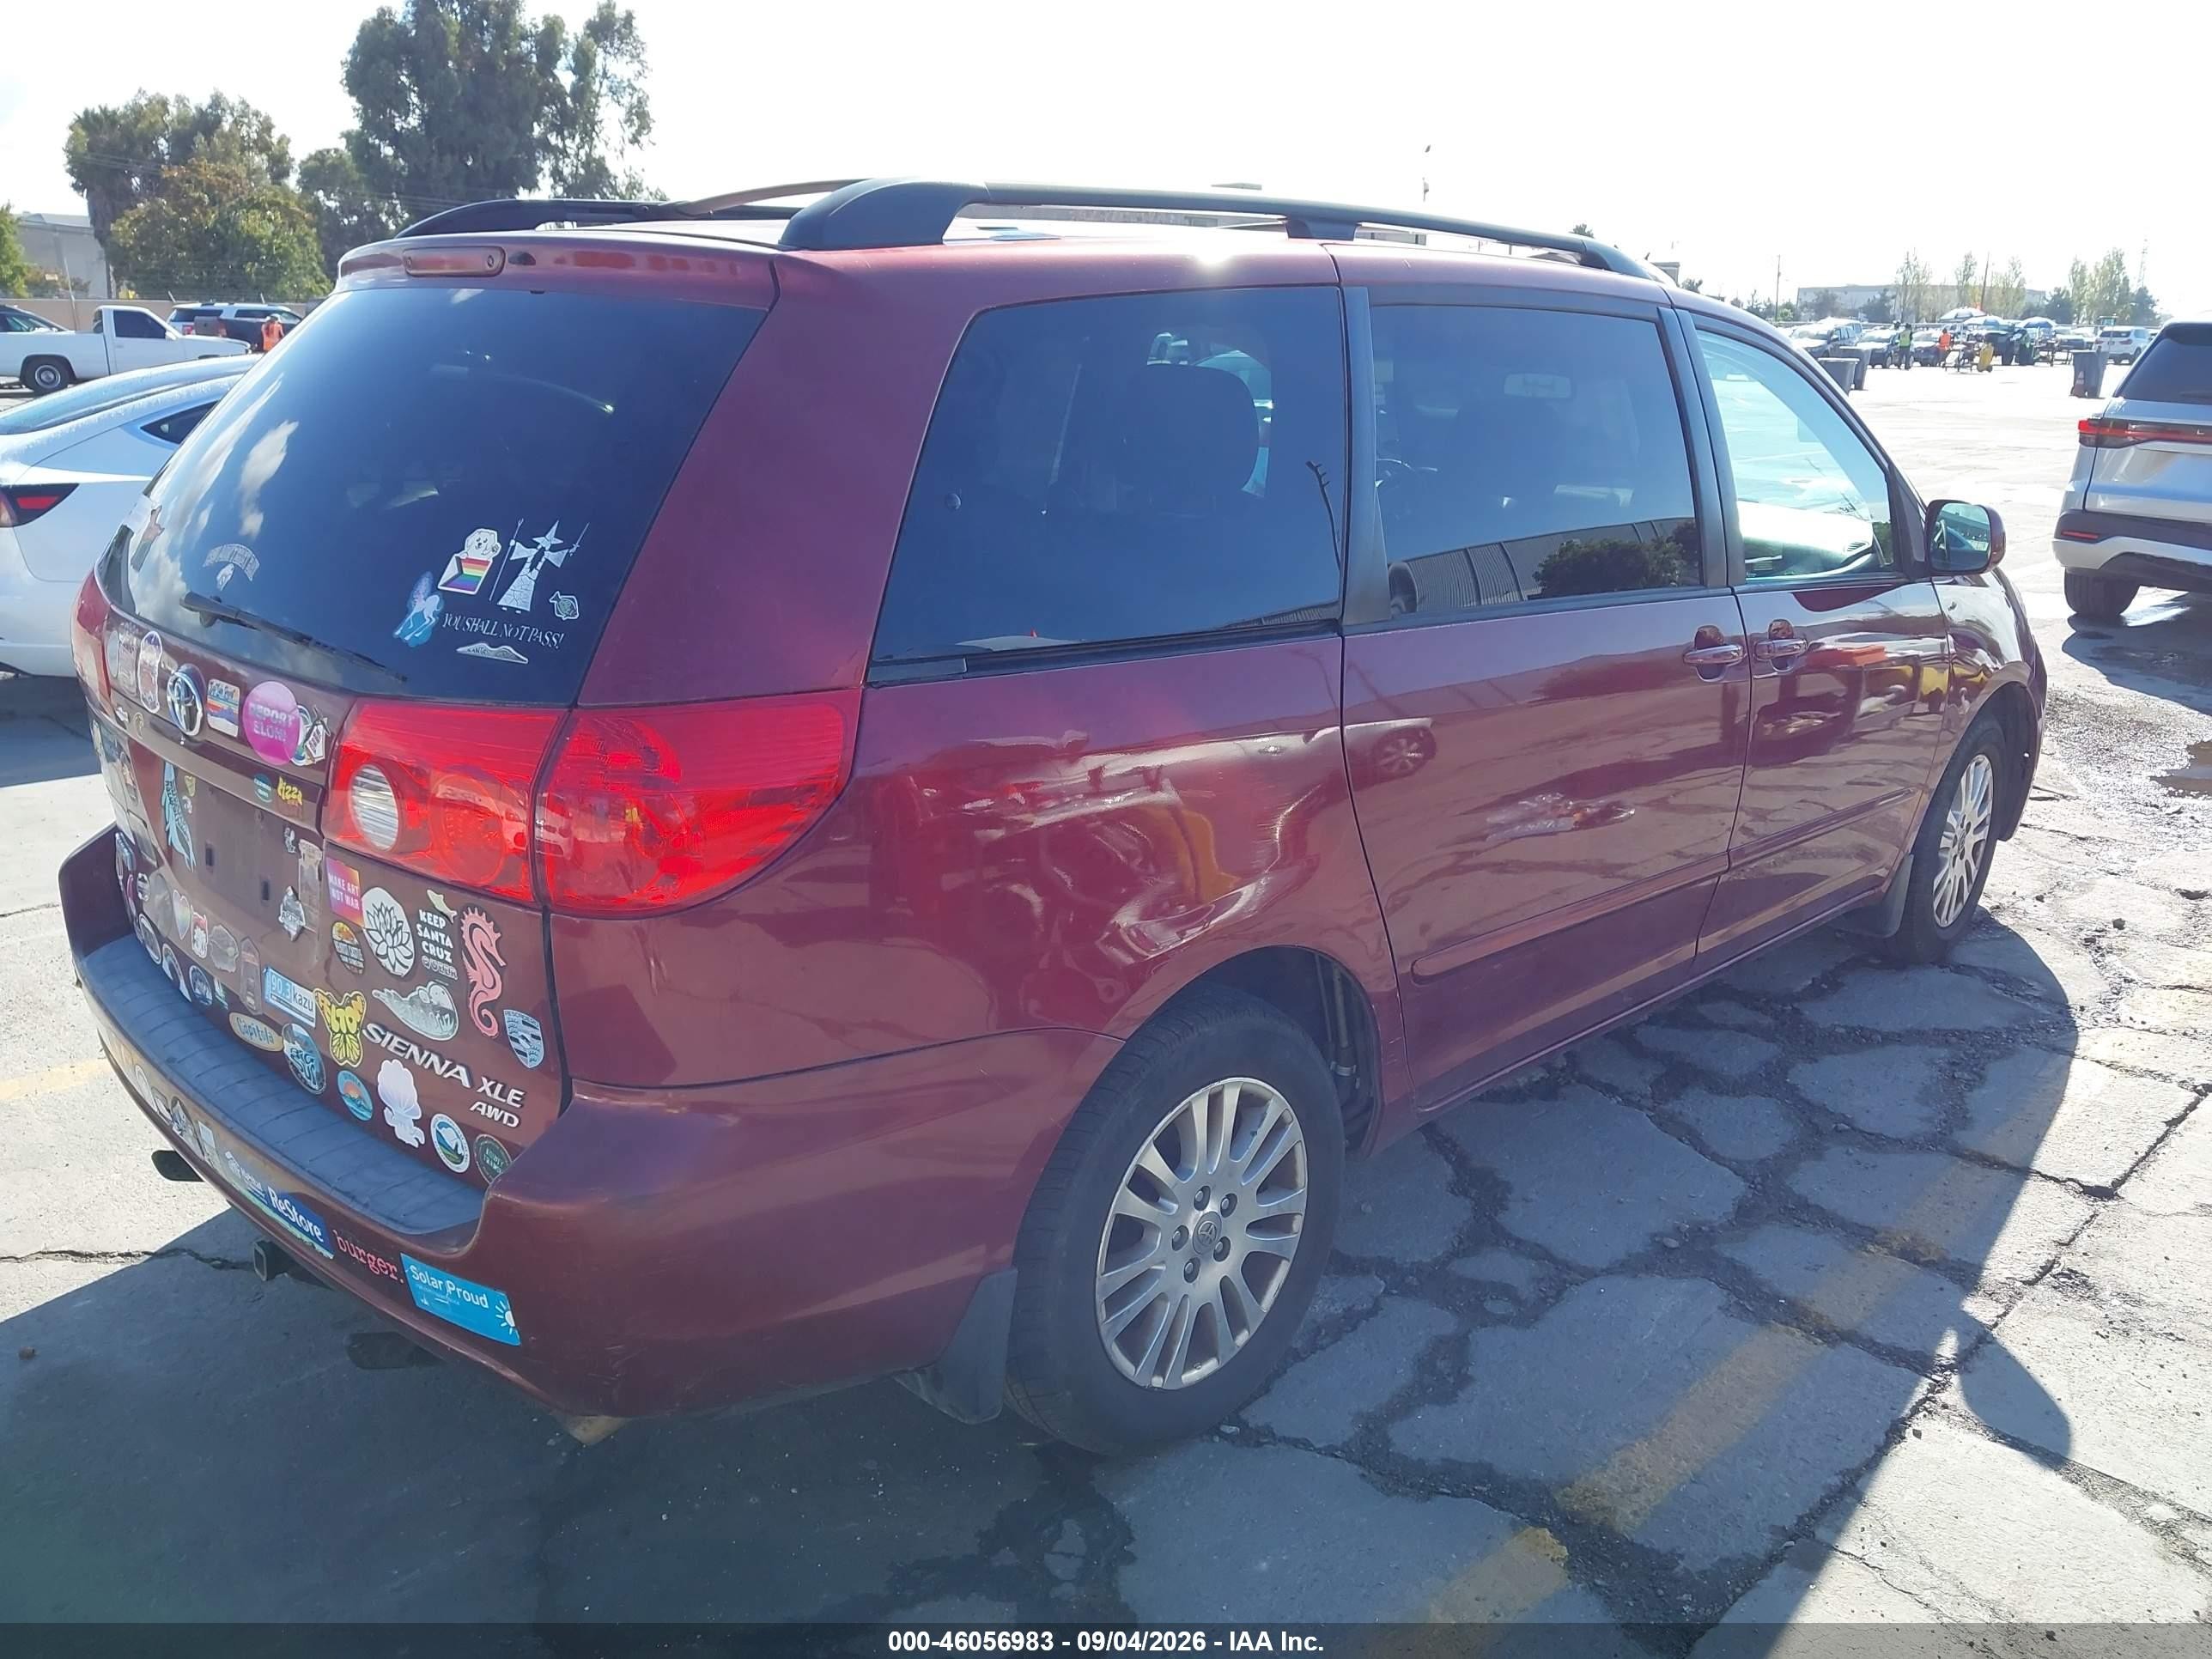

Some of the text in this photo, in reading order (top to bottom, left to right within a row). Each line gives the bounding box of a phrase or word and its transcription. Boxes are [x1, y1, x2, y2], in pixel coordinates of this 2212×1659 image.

[443, 612, 566, 650] YOU SHALL NOT PASS!
[328, 873, 360, 897] MAKE ART
[331, 888, 360, 910] NOT WAR
[418, 908, 447, 930] KEEP
[416, 923, 454, 949] SANTA
[421, 940, 453, 963] CRUZ
[271, 975, 291, 999] 90.3
[293, 986, 313, 1012] kazu
[362, 1023, 526, 1108] SIENNA XLE
[469, 1100, 520, 1127] AWD
[267, 1185, 325, 1243] ReStore
[331, 1229, 405, 1285] burger.
[409, 1264, 444, 1291] Solar
[446, 1279, 489, 1310] Proud
